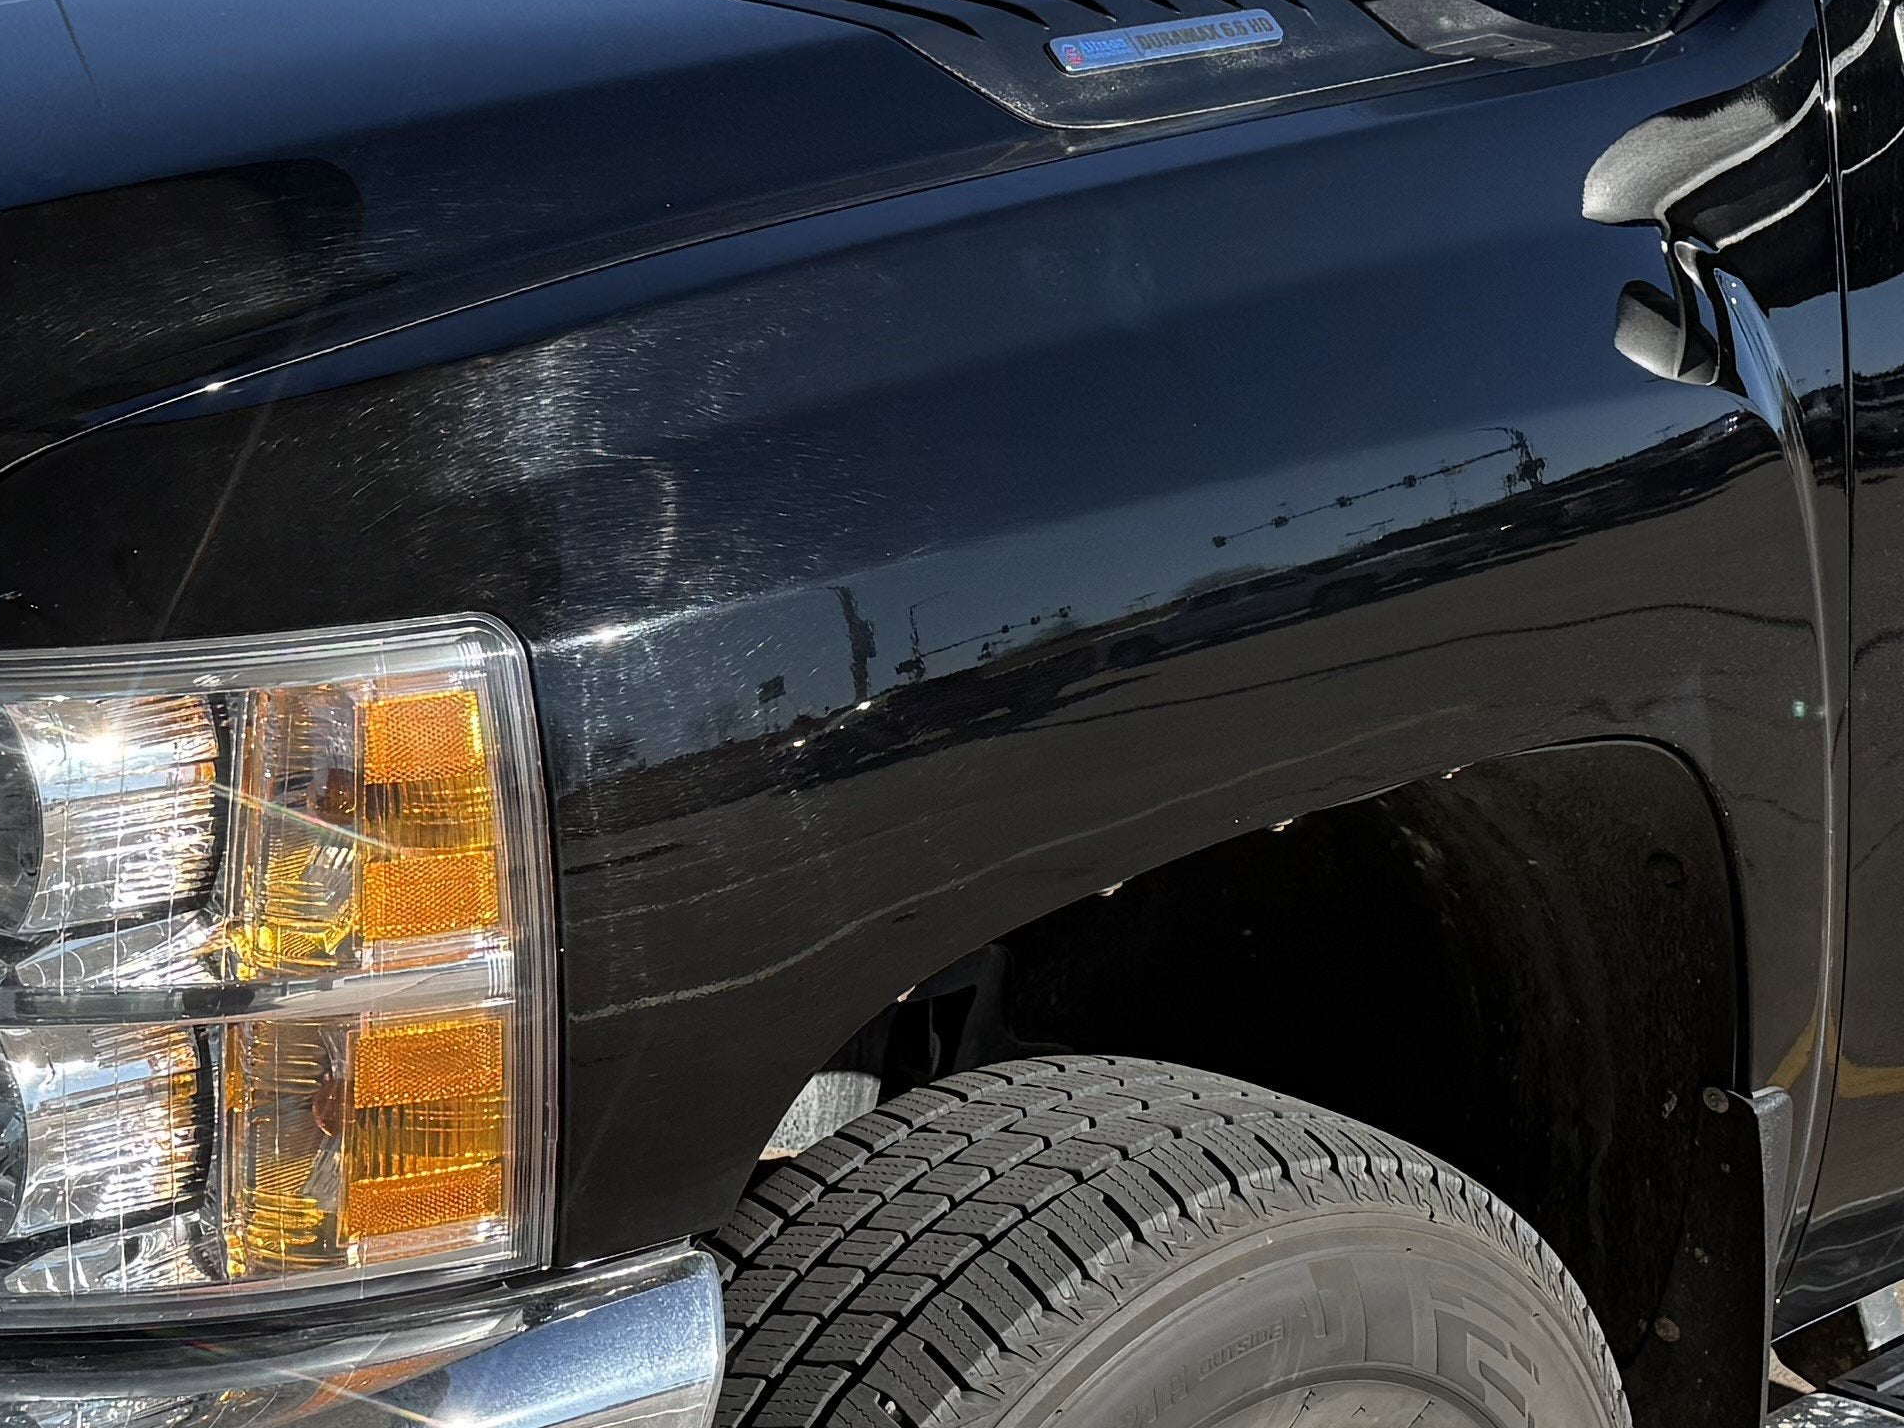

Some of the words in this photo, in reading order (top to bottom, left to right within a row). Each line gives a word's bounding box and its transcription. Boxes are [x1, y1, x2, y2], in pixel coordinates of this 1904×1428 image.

[1137, 25, 1221, 51] DURAMAX
[1219, 20, 1248, 38] 6.6
[1246, 17, 1274, 34] HD
